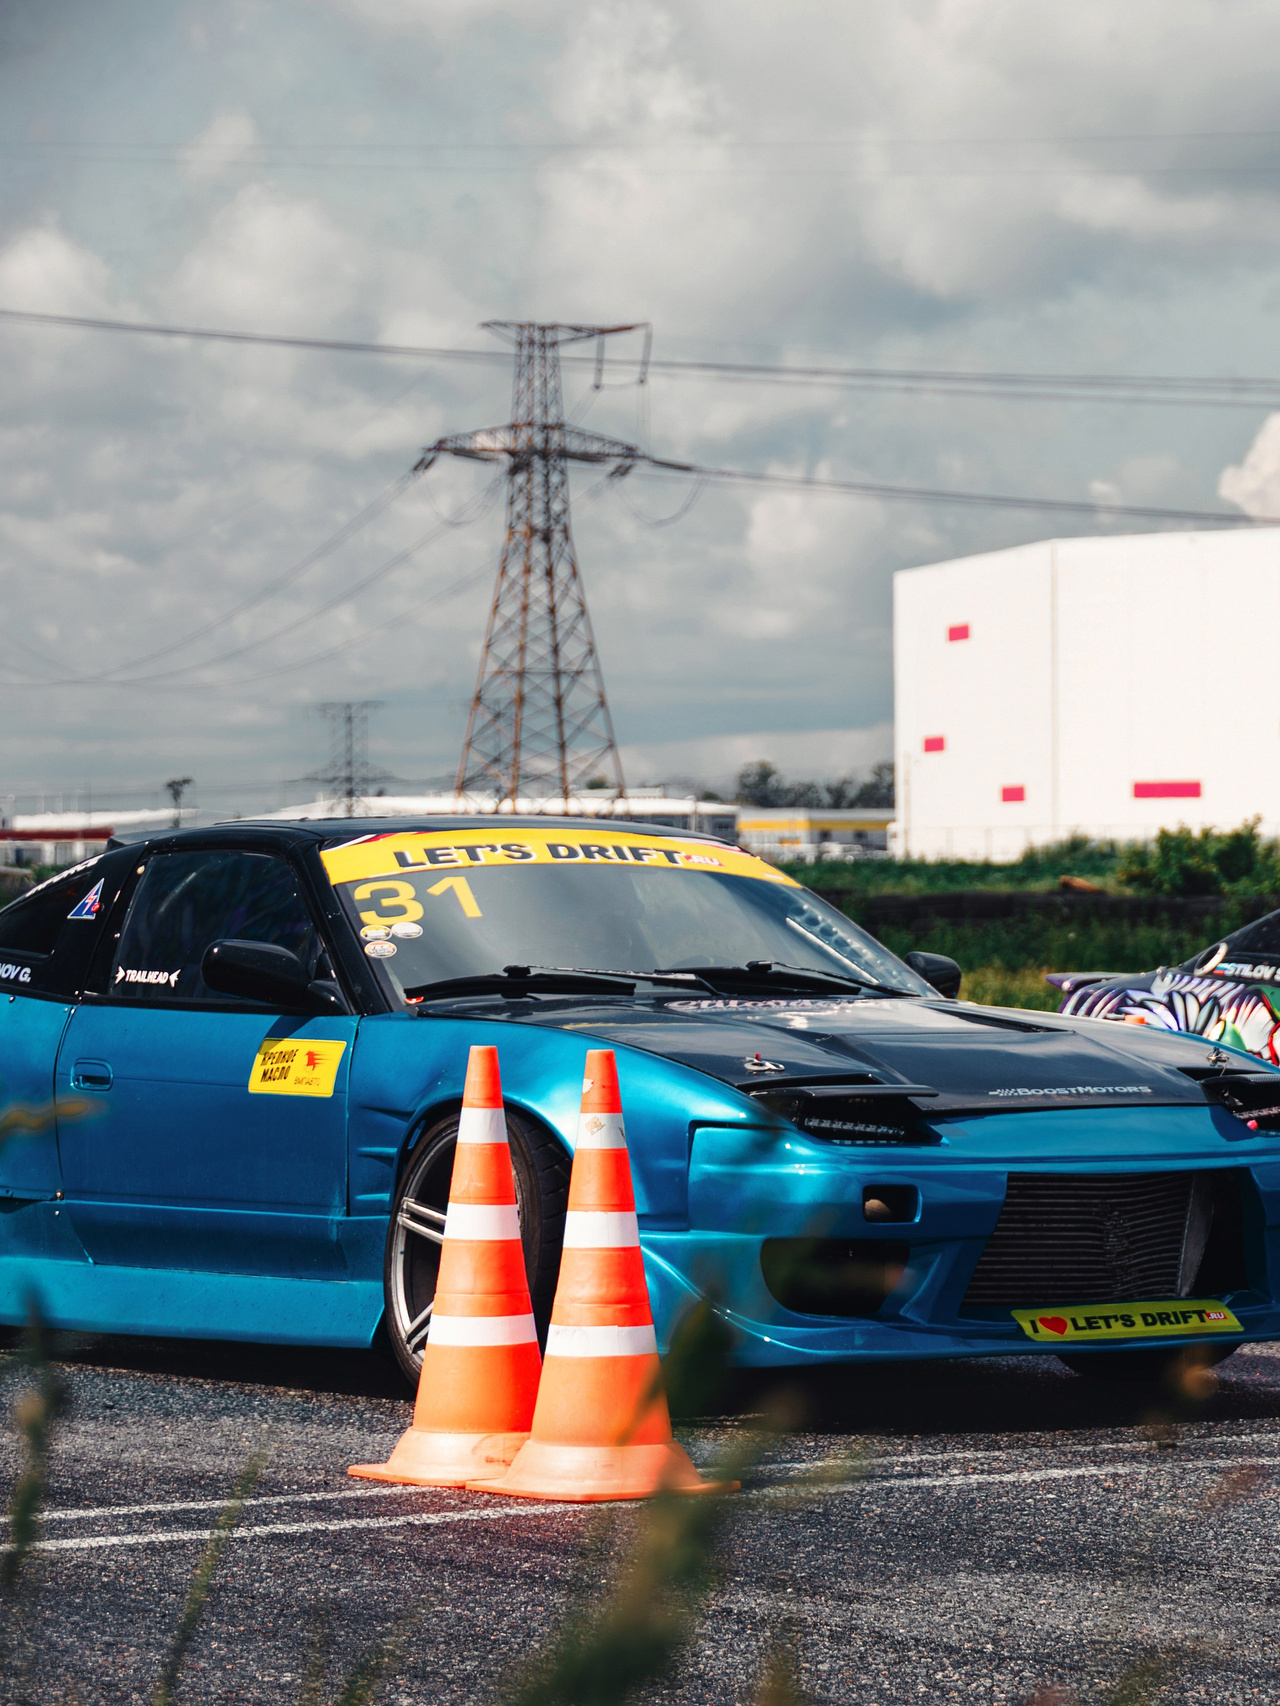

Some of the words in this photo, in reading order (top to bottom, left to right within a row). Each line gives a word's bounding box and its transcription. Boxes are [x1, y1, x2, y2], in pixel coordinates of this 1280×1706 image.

[394, 844, 536, 869] LET'S
[354, 876, 483, 926] 31
[18, 967, 31, 983] G.
[125, 969, 169, 984] TRAILHEAD
[1225, 962, 1276, 981] STILOV
[1029, 1319, 1039, 1333] I
[1070, 1313, 1136, 1332] LET'S
